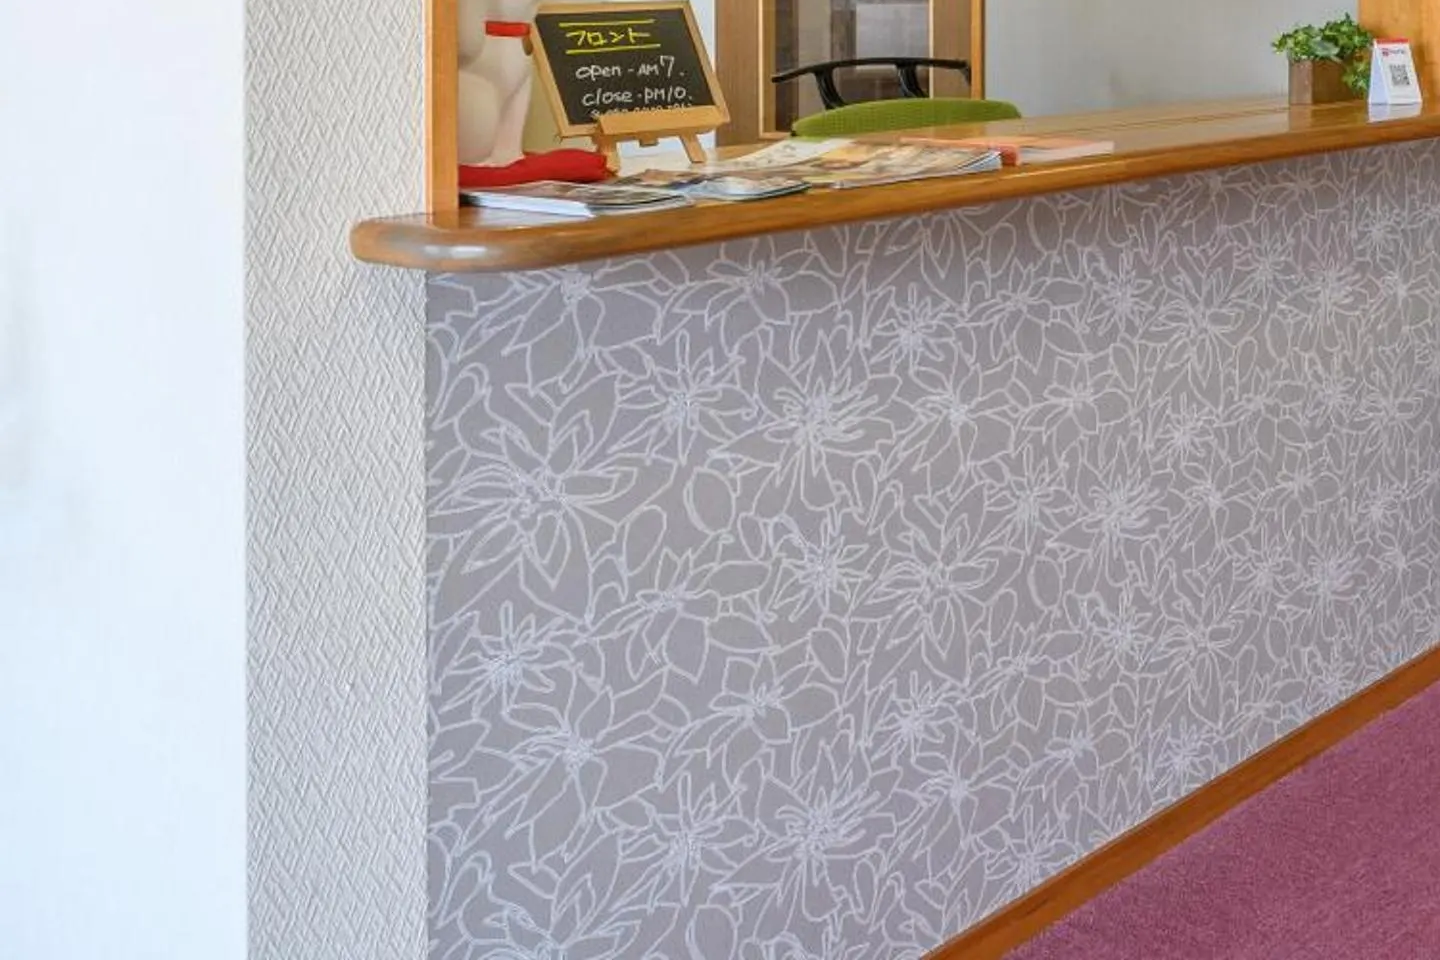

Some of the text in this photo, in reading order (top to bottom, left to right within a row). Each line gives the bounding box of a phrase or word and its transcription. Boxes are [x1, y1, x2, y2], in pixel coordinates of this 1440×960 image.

[565, 27, 651, 46] フロント
[575, 64, 622, 81] open
[582, 88, 633, 107] close
